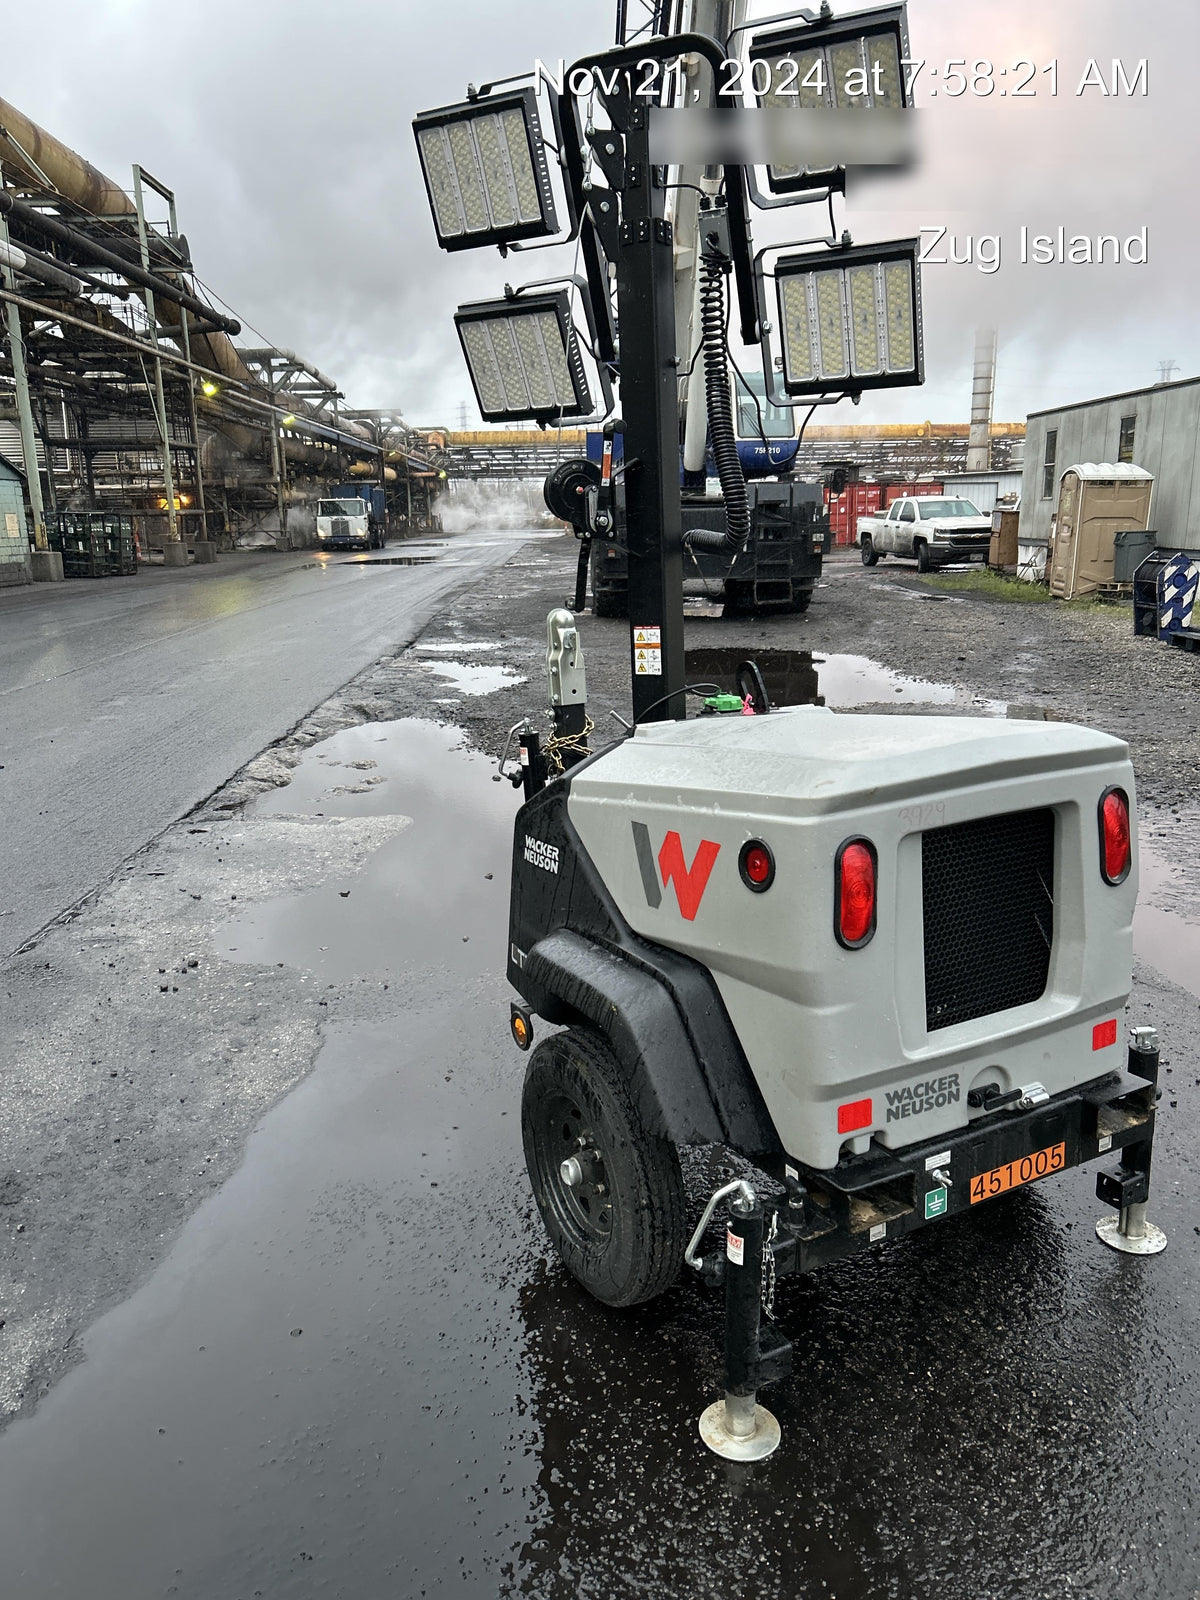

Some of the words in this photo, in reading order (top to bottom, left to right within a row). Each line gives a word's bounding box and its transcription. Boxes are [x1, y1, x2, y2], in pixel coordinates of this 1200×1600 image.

[524, 847, 559, 875] NEUSON
[525, 834, 560, 861] WACKER
[885, 1073, 960, 1107] WACKER
[886, 1087, 960, 1123] NEUSON
[972, 1144, 1063, 1200] 451005
